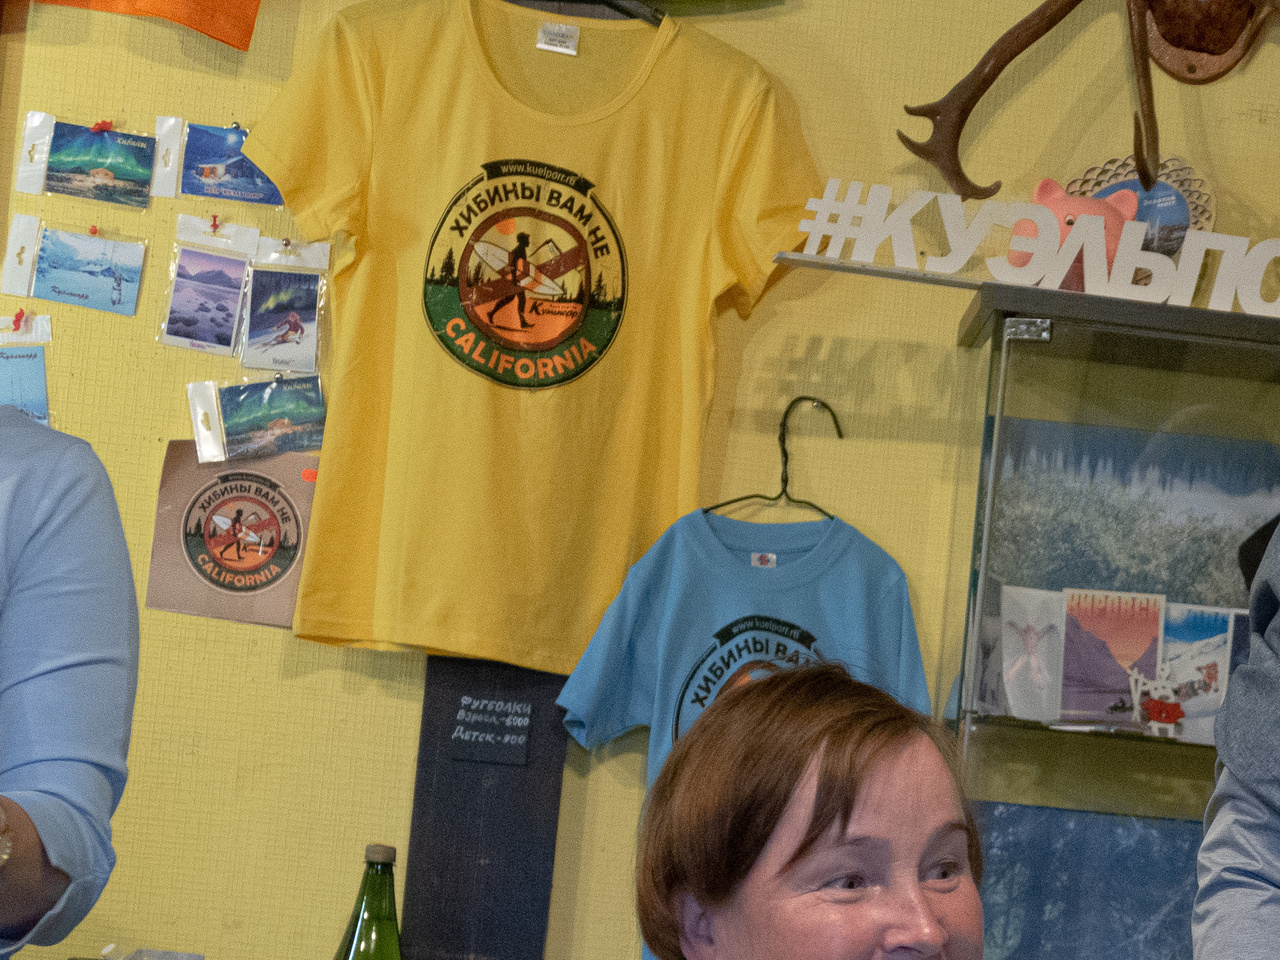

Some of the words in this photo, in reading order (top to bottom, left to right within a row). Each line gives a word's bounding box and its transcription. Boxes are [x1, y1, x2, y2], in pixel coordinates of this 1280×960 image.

[450, 182, 541, 238] ХИБИНЫ
[546, 188, 595, 226] ВАМ
[588, 226, 611, 259] НЕ
[445, 318, 598, 379] CALIFORNIA
[198, 483, 251, 512] ХИБИНЫ
[254, 487, 280, 507] ВАМ
[277, 506, 291, 524] НЕ
[197, 554, 281, 587] CALIFORNIA
[690, 636, 770, 708] ХИБИНЫ
[774, 642, 812, 667] ВА
